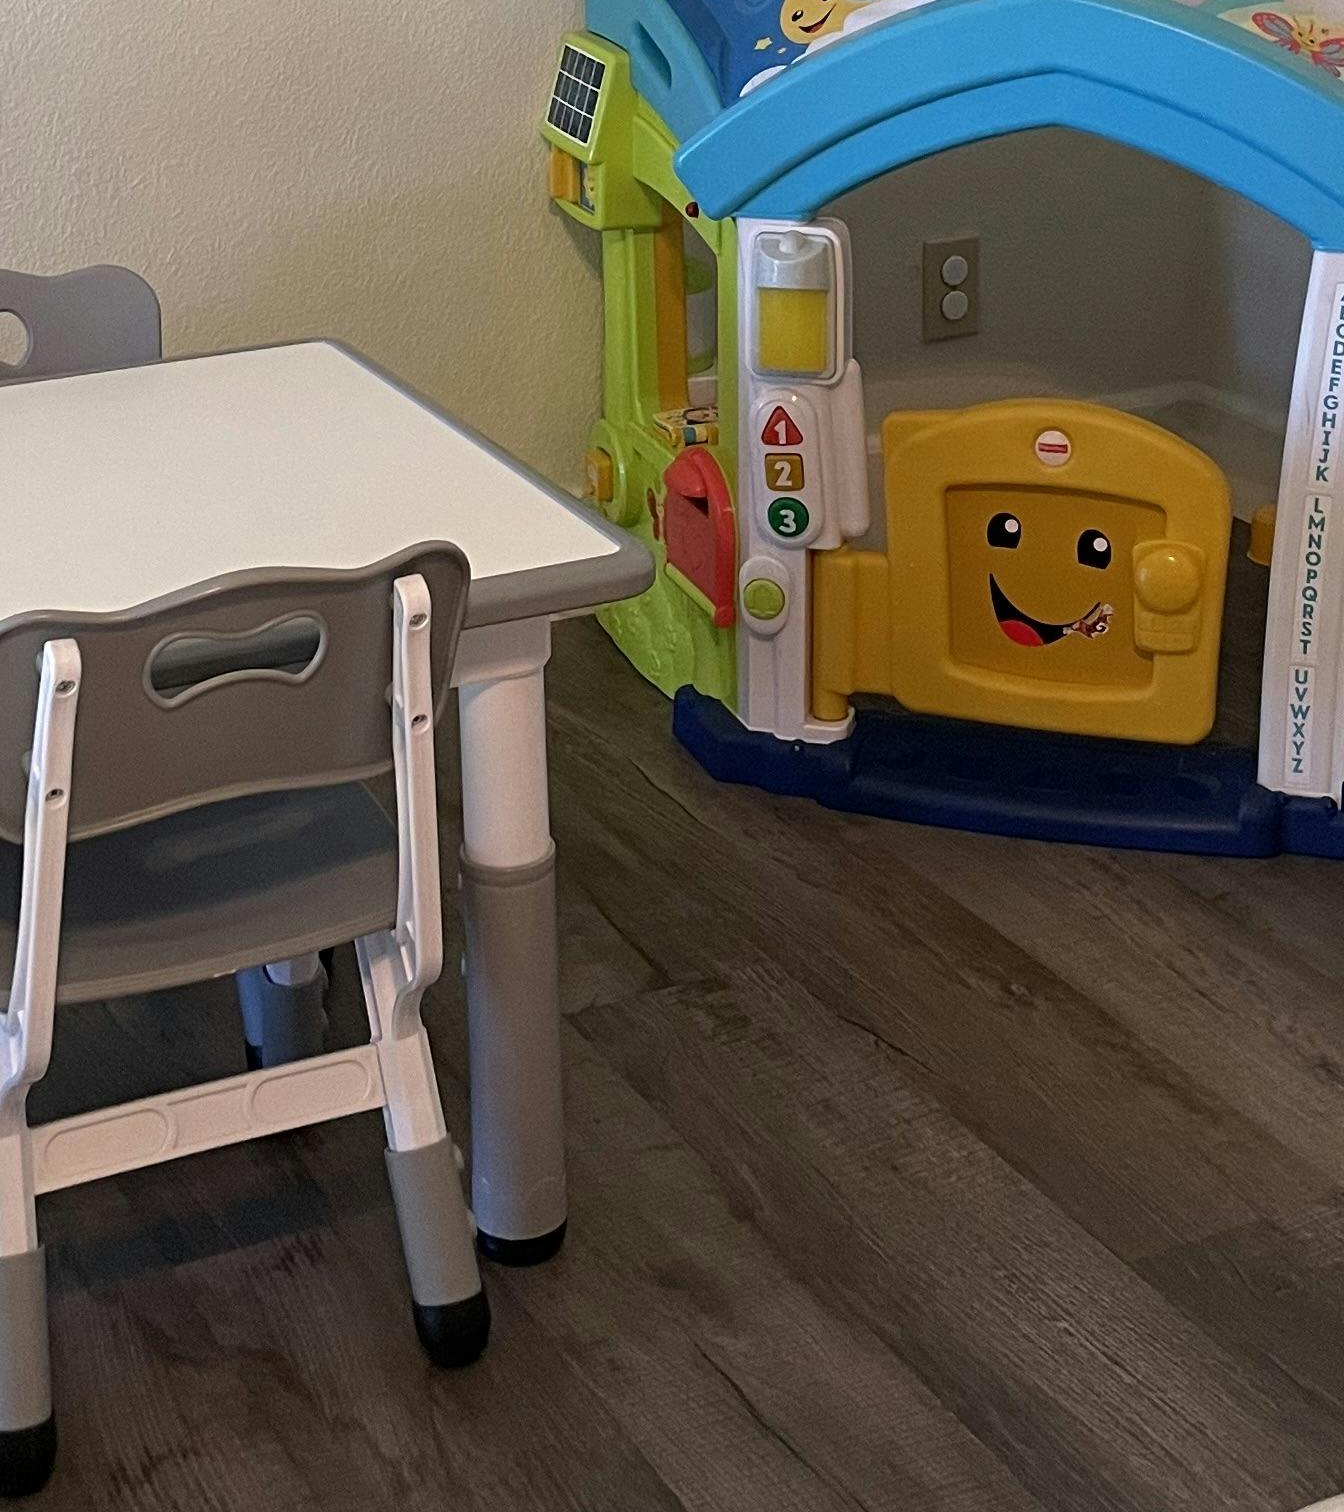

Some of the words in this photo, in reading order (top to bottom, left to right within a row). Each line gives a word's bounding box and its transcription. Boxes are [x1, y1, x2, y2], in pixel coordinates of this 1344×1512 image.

[775, 421, 786, 444] 1
[775, 461, 792, 486] 2
[780, 510, 796, 532] 3
